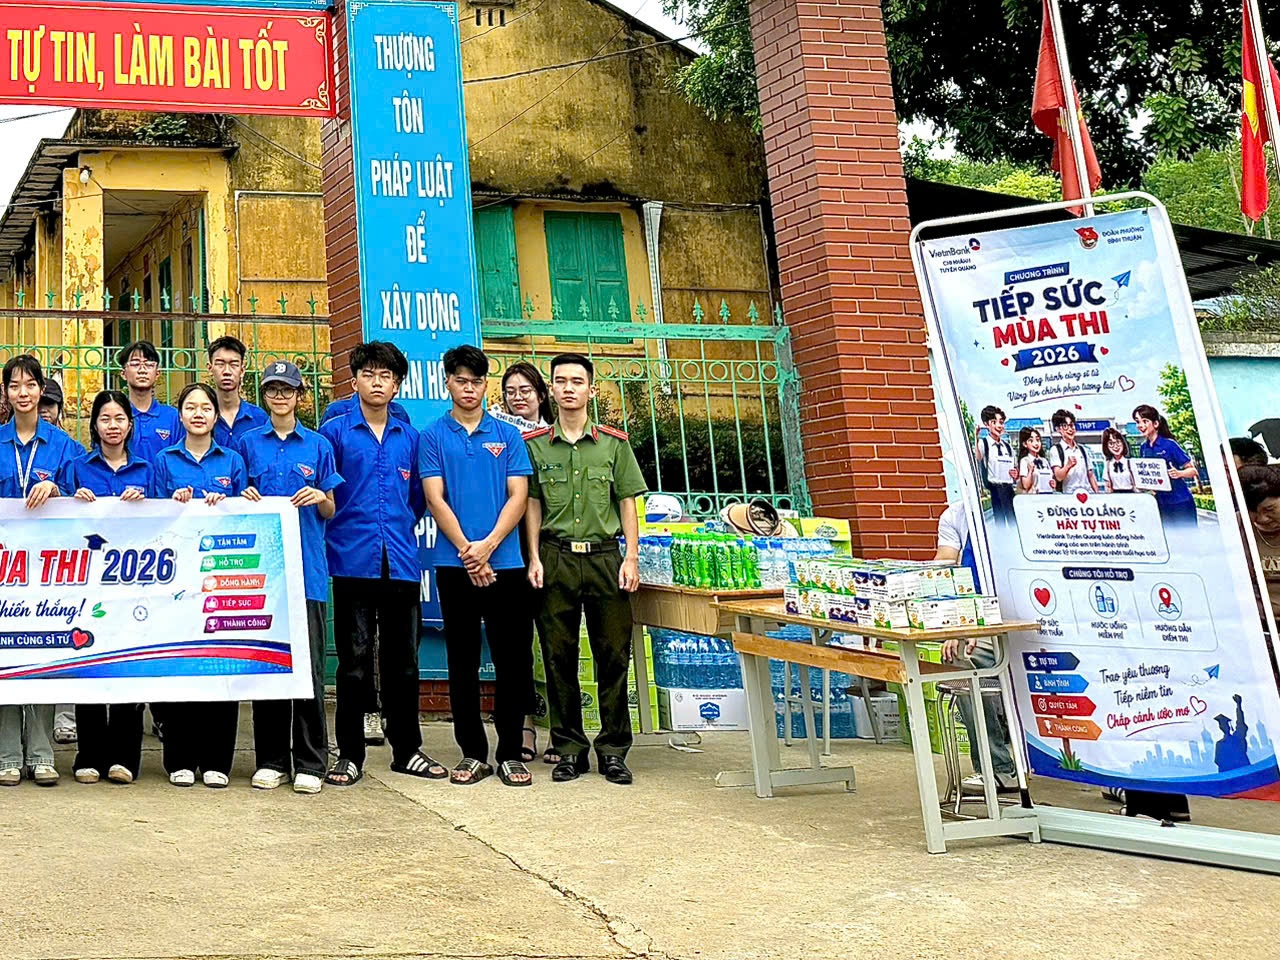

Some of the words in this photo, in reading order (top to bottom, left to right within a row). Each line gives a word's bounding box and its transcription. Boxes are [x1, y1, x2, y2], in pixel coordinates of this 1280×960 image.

[7, 24, 46, 94] TỰ
[50, 30, 105, 91] TIN,
[113, 22, 174, 87] LÀM
[183, 26, 231, 89] BÀI
[238, 21, 289, 91] TỐT
[373, 32, 436, 79] THƯỢNG
[392, 89, 425, 134] TÔN
[370, 152, 413, 197] PHÁP
[416, 153, 454, 207] LUẬT
[405, 210, 428, 264] ĐỂ
[1009, 268, 1042, 282] CHƯƠNG
[1042, 265, 1065, 278] TRÌNH
[380, 282, 412, 330] XÂY
[415, 288, 461, 340] DỰNG
[972, 285, 1035, 323] TIẾP
[1042, 278, 1106, 311] SỨC
[992, 316, 1058, 349] MÙA
[1059, 311, 1110, 338] THI
[1031, 345, 1080, 366] 2026
[1047, 505, 1078, 517] ĐỪNG
[1080, 507, 1095, 517] LO
[1096, 503, 1126, 517] LẮNG
[1056, 518, 1078, 530] HÃY
[1081, 519, 1098, 532] TỰ
[1100, 520, 1121, 530] TIN!
[39, 549, 89, 586] THI
[100, 547, 176, 586] 2026
[35, 598, 87, 627] thắng!
[16, 634, 44, 645] CÙNG
[1099, 668, 1121, 684] Trao
[1122, 667, 1138, 685] yêu
[1138, 662, 1170, 679] thương
[1113, 689, 1134, 708] Tiếp
[1136, 685, 1158, 701] niềm
[1159, 684, 1174, 697] tin
